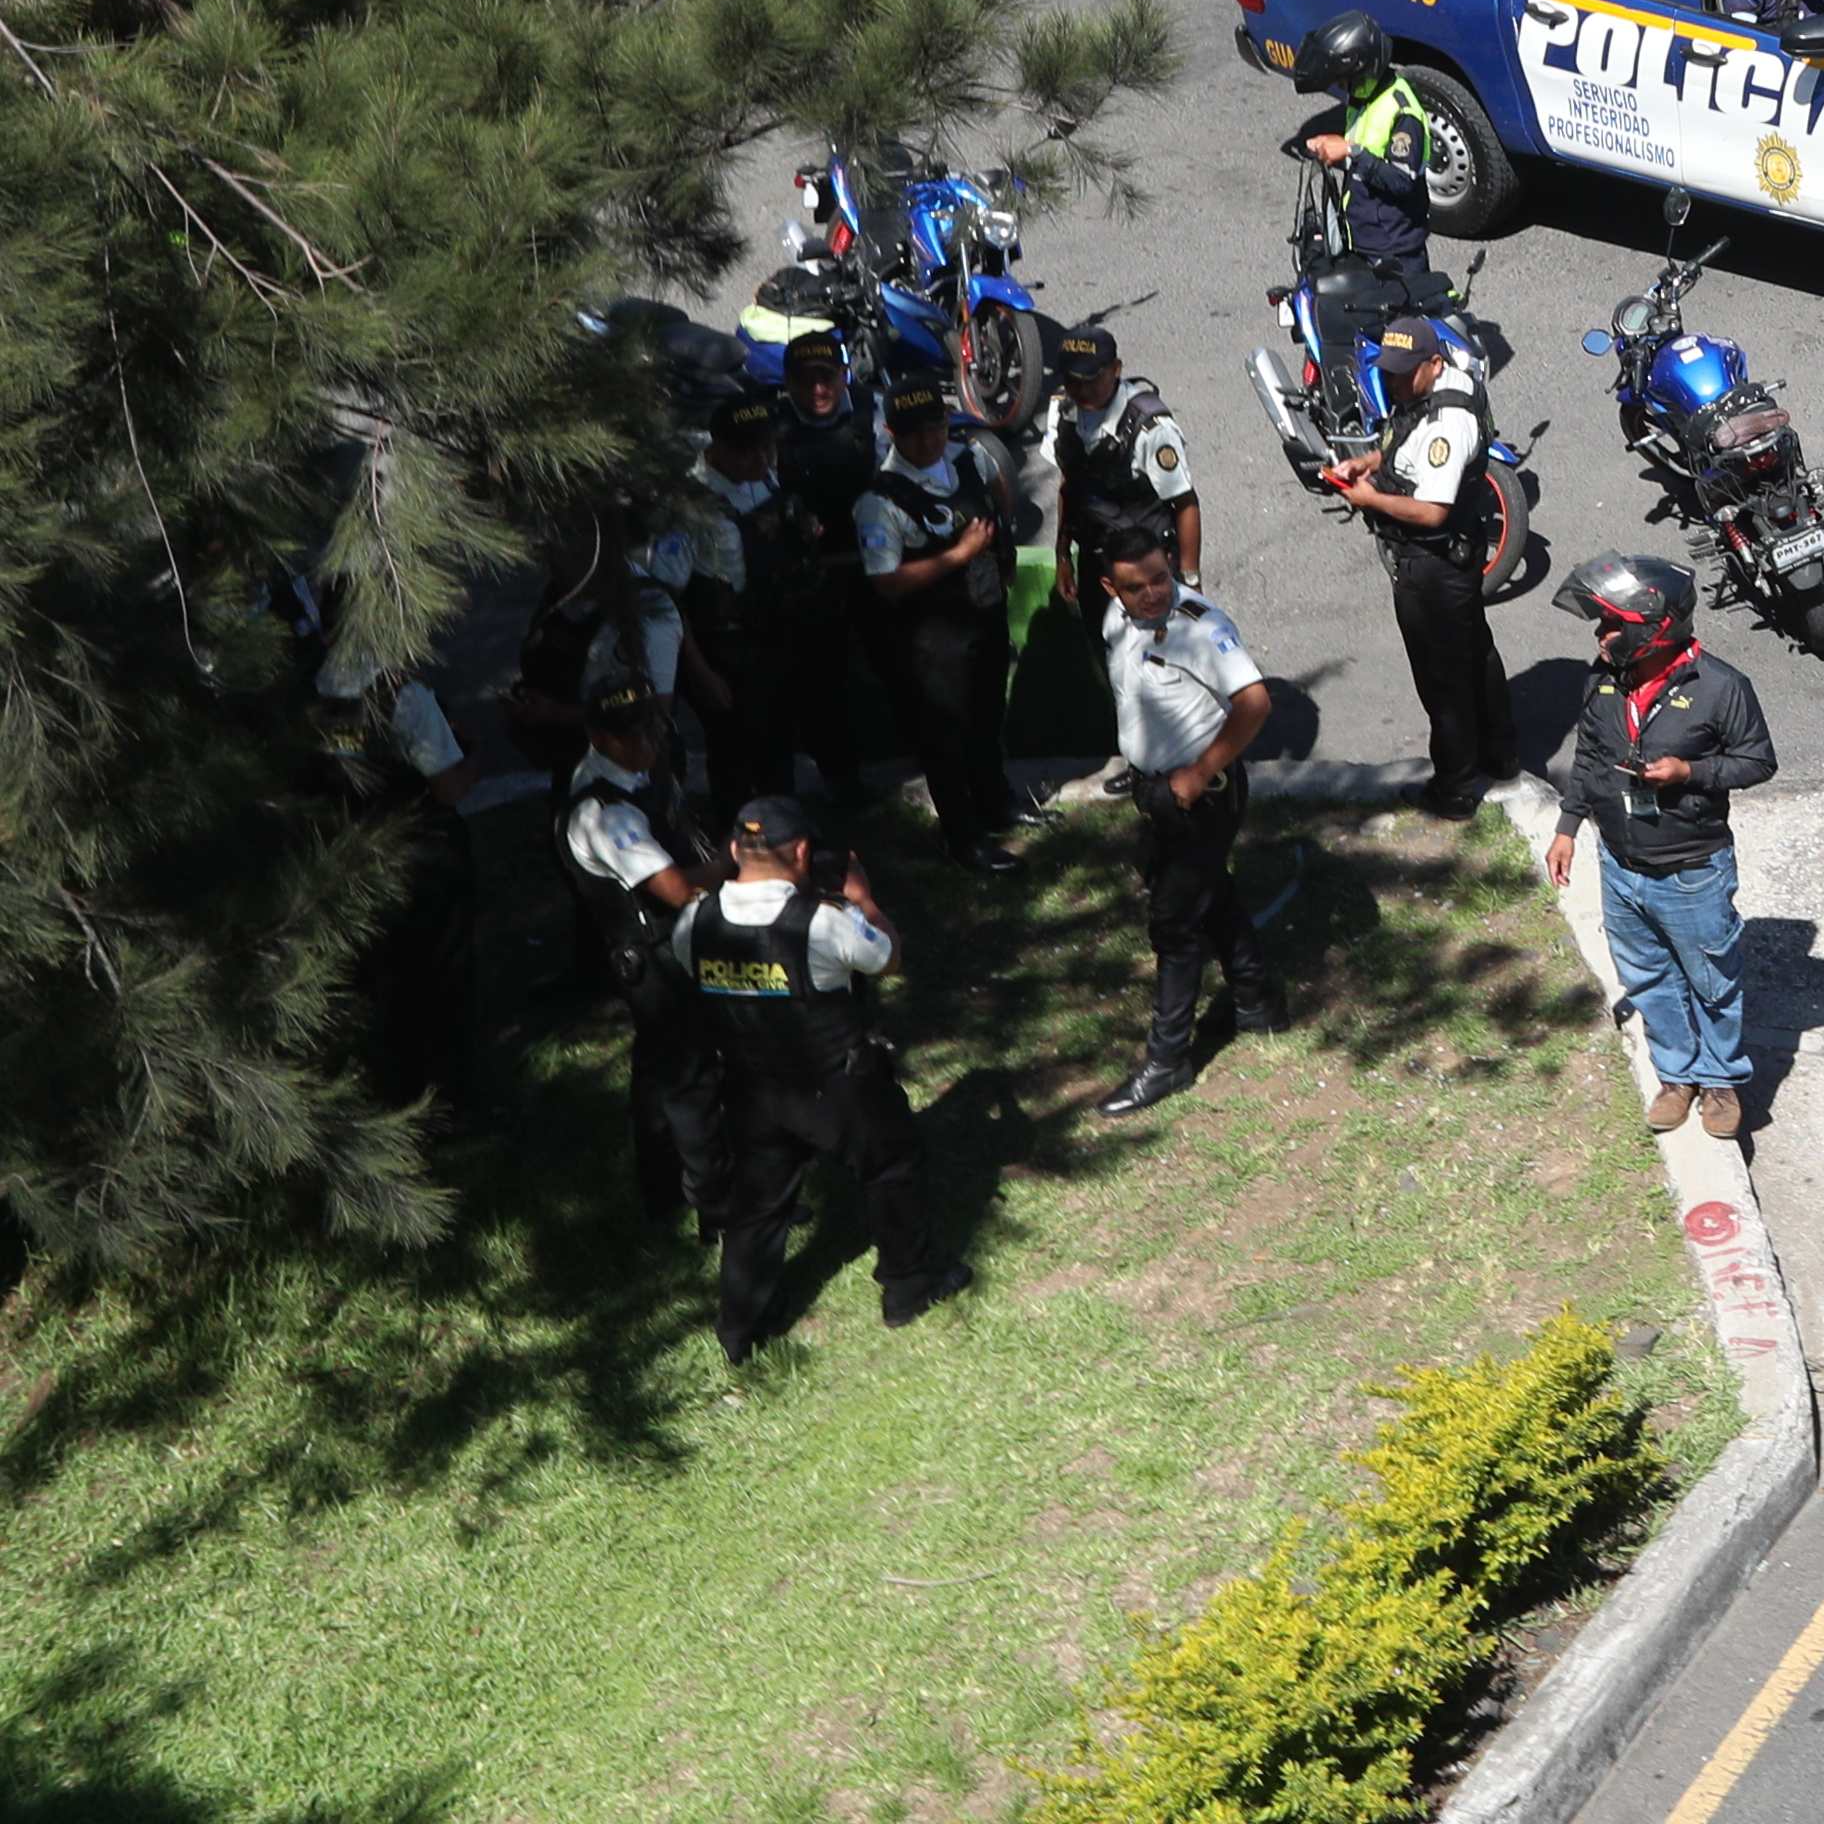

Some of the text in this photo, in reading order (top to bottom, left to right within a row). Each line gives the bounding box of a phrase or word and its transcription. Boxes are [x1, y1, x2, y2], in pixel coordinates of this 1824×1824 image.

[1264, 38, 1297, 71] GUA
[1573, 78, 1638, 113] SERVICIO
[1567, 97, 1650, 138] INTEGRIDAD
[1548, 116, 1675, 169] PROFESIONALISMO
[1776, 533, 1823, 560] PMT-367
[700, 958, 789, 983] POLICIA
